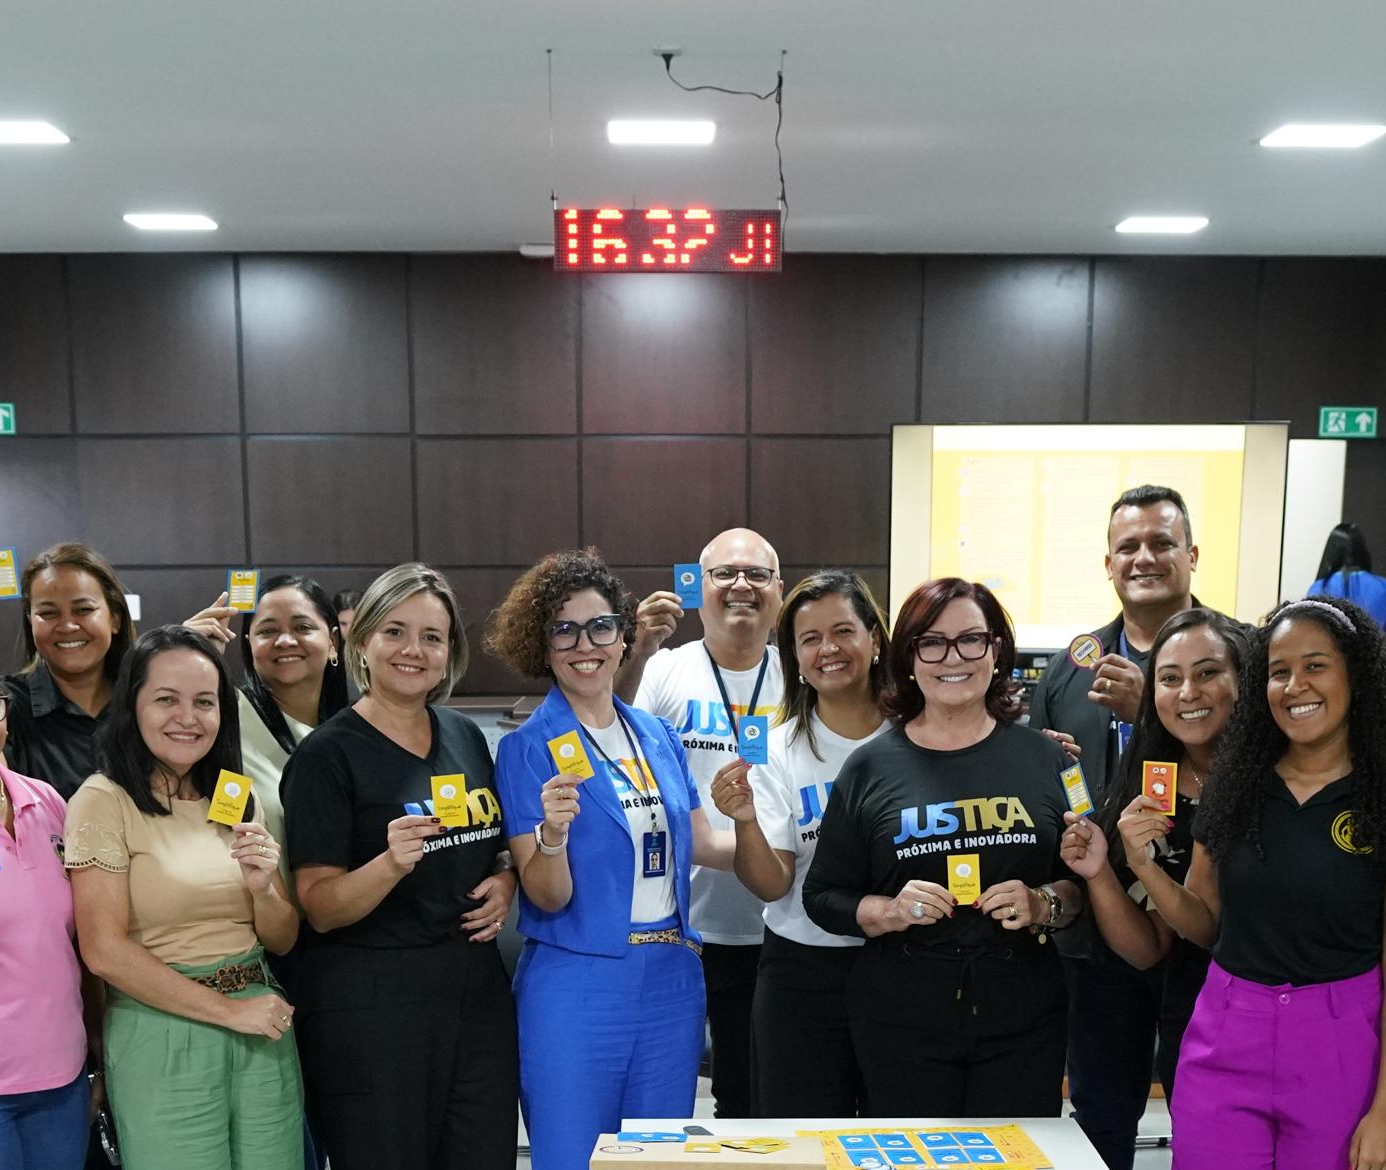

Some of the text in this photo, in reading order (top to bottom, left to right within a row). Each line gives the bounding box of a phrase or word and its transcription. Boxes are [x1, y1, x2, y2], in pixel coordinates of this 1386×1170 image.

[683, 738, 725, 751] RÓXIMA
[894, 797, 1035, 844] JUSTIÇA
[423, 836, 453, 853] ÓXIMA
[454, 835, 460, 845] E
[896, 832, 1037, 860] PRÓXIMA E INOVADORA
